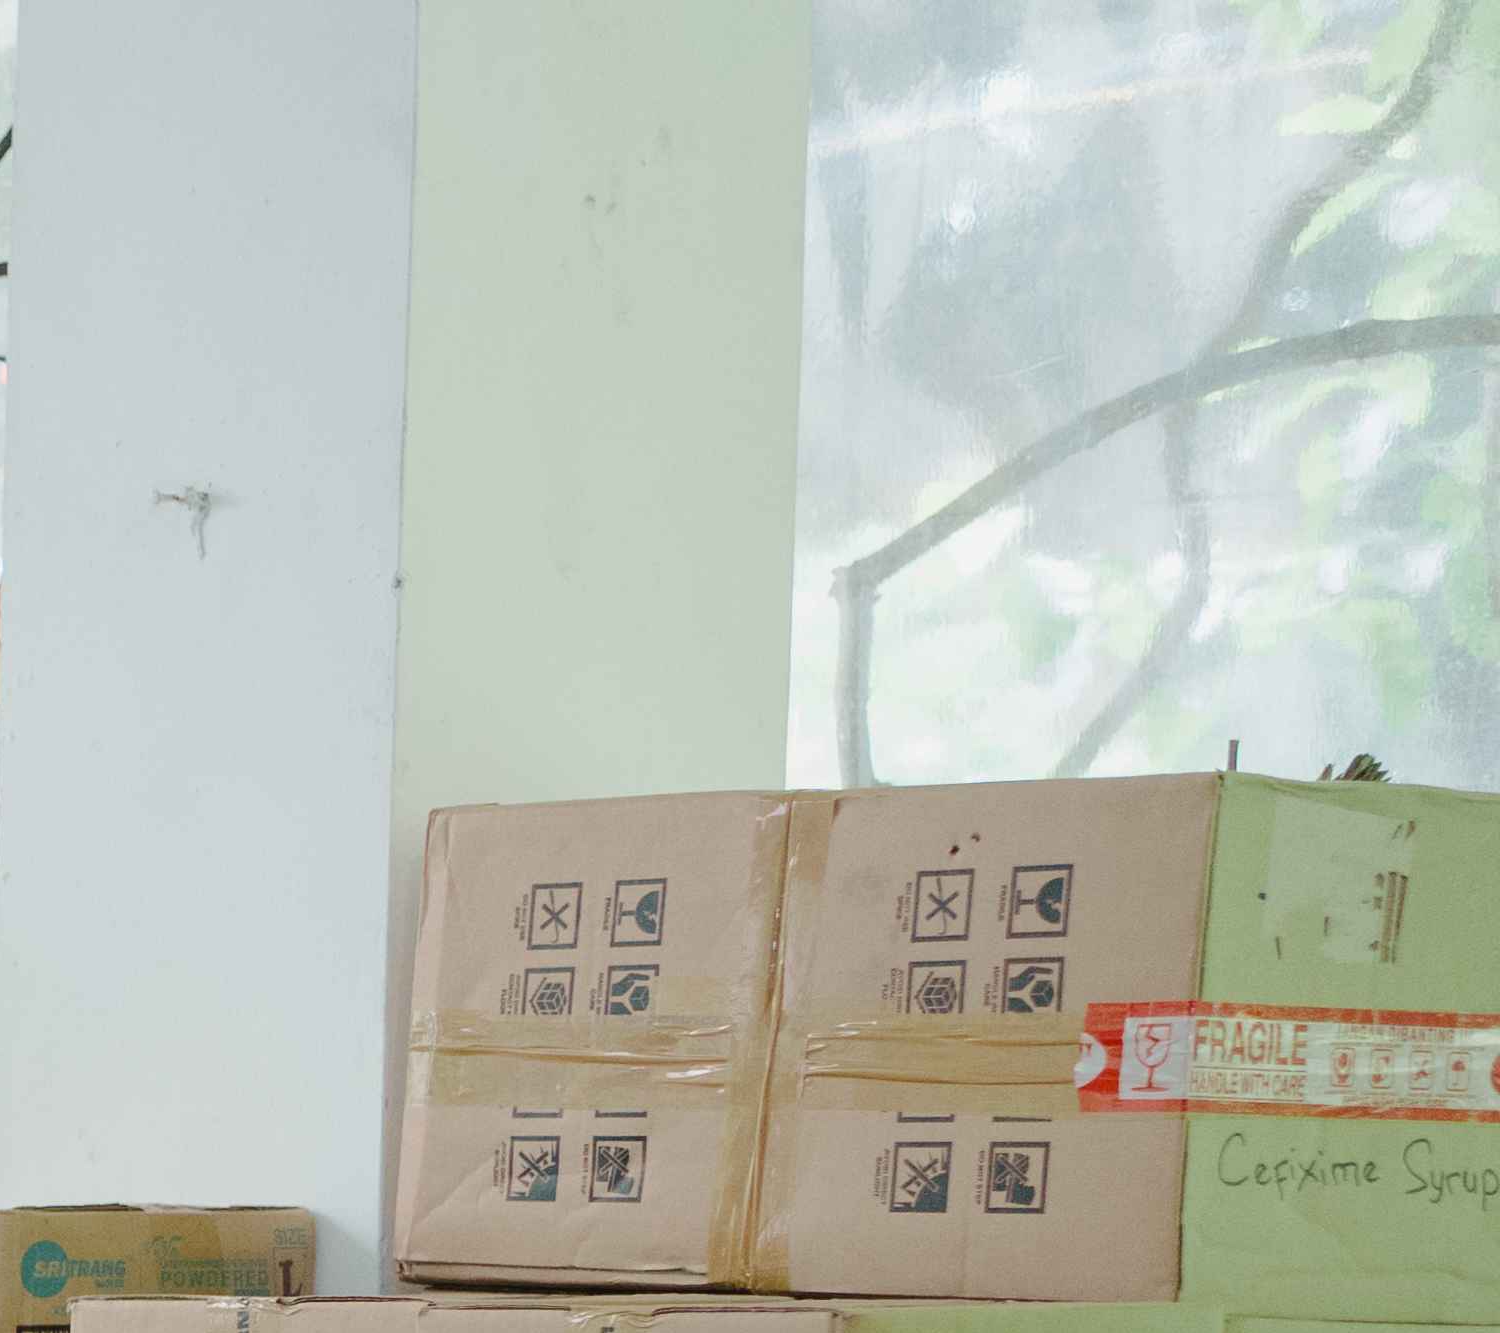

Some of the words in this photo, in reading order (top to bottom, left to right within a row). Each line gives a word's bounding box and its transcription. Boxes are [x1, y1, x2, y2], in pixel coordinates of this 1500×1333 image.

[1193, 1018, 1308, 1066] FRAGILE
[1189, 1071, 1241, 1094] HANDLE
[1272, 1075, 1307, 1097] CARE
[1218, 1132, 1380, 1200] Cefixime
[1402, 1138, 1500, 1211] Syrup
